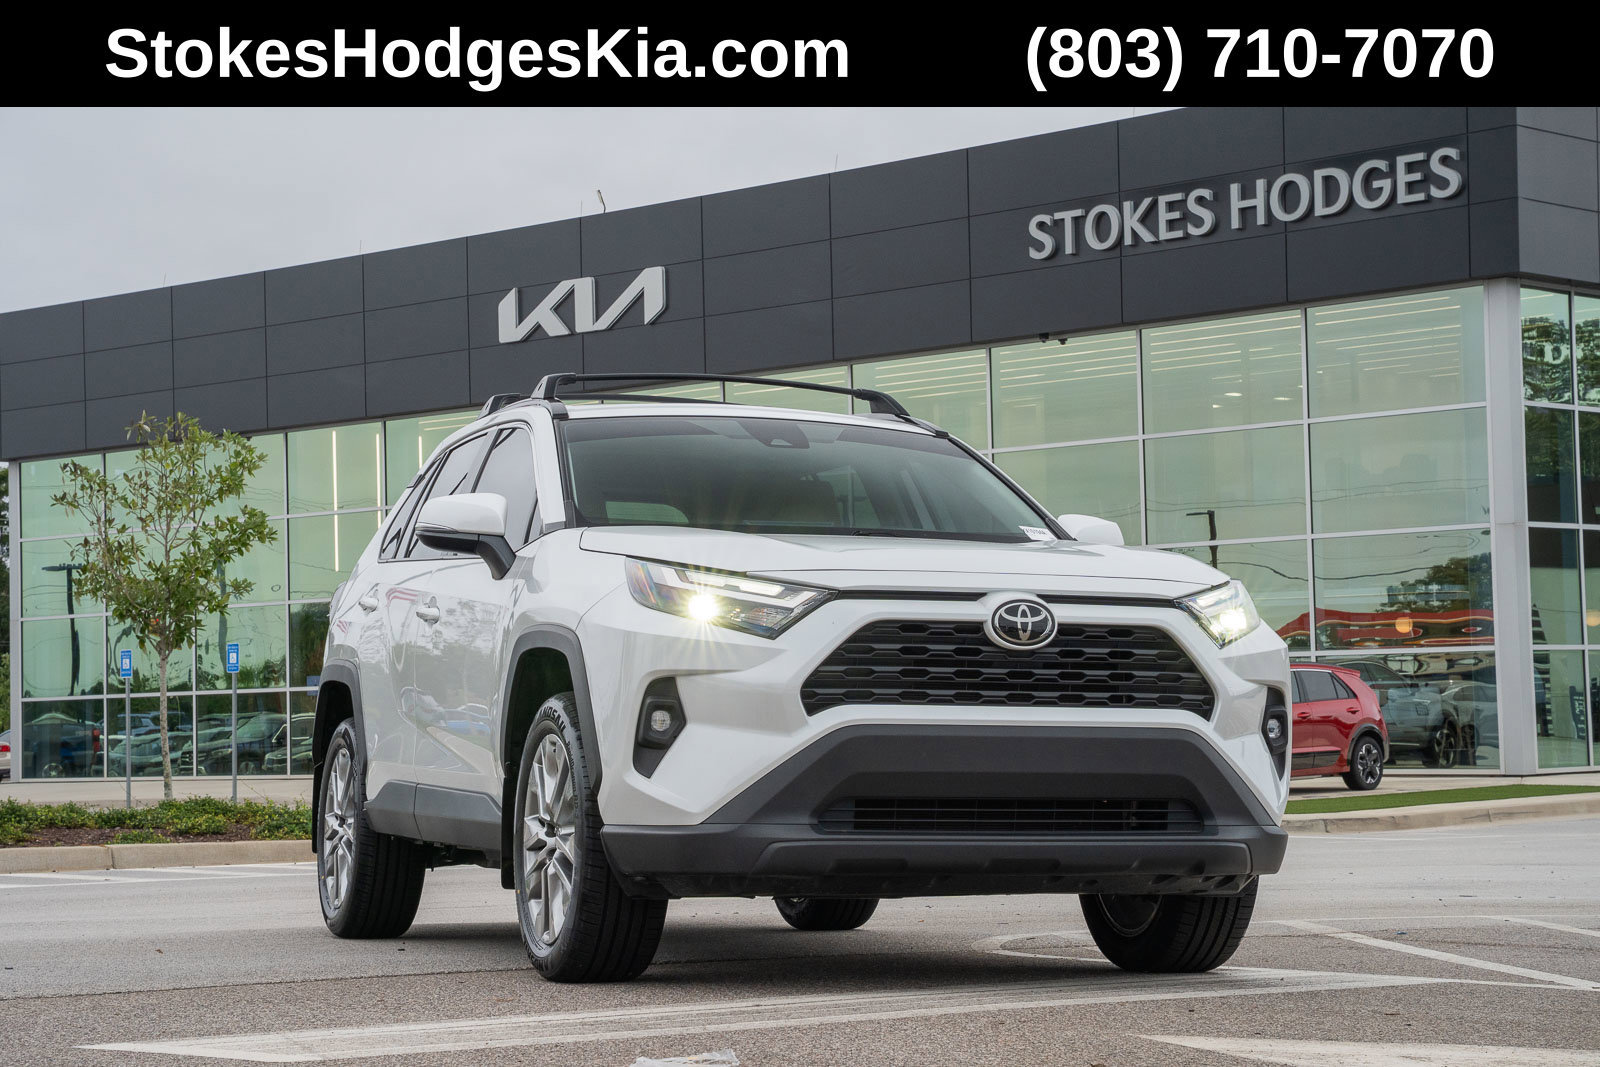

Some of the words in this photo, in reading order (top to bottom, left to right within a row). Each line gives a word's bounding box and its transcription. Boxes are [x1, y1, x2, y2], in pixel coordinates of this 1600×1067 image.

[1028, 188, 1216, 260] STOKES
[1229, 147, 1463, 230] HODGES
[498, 266, 666, 344] KIA
